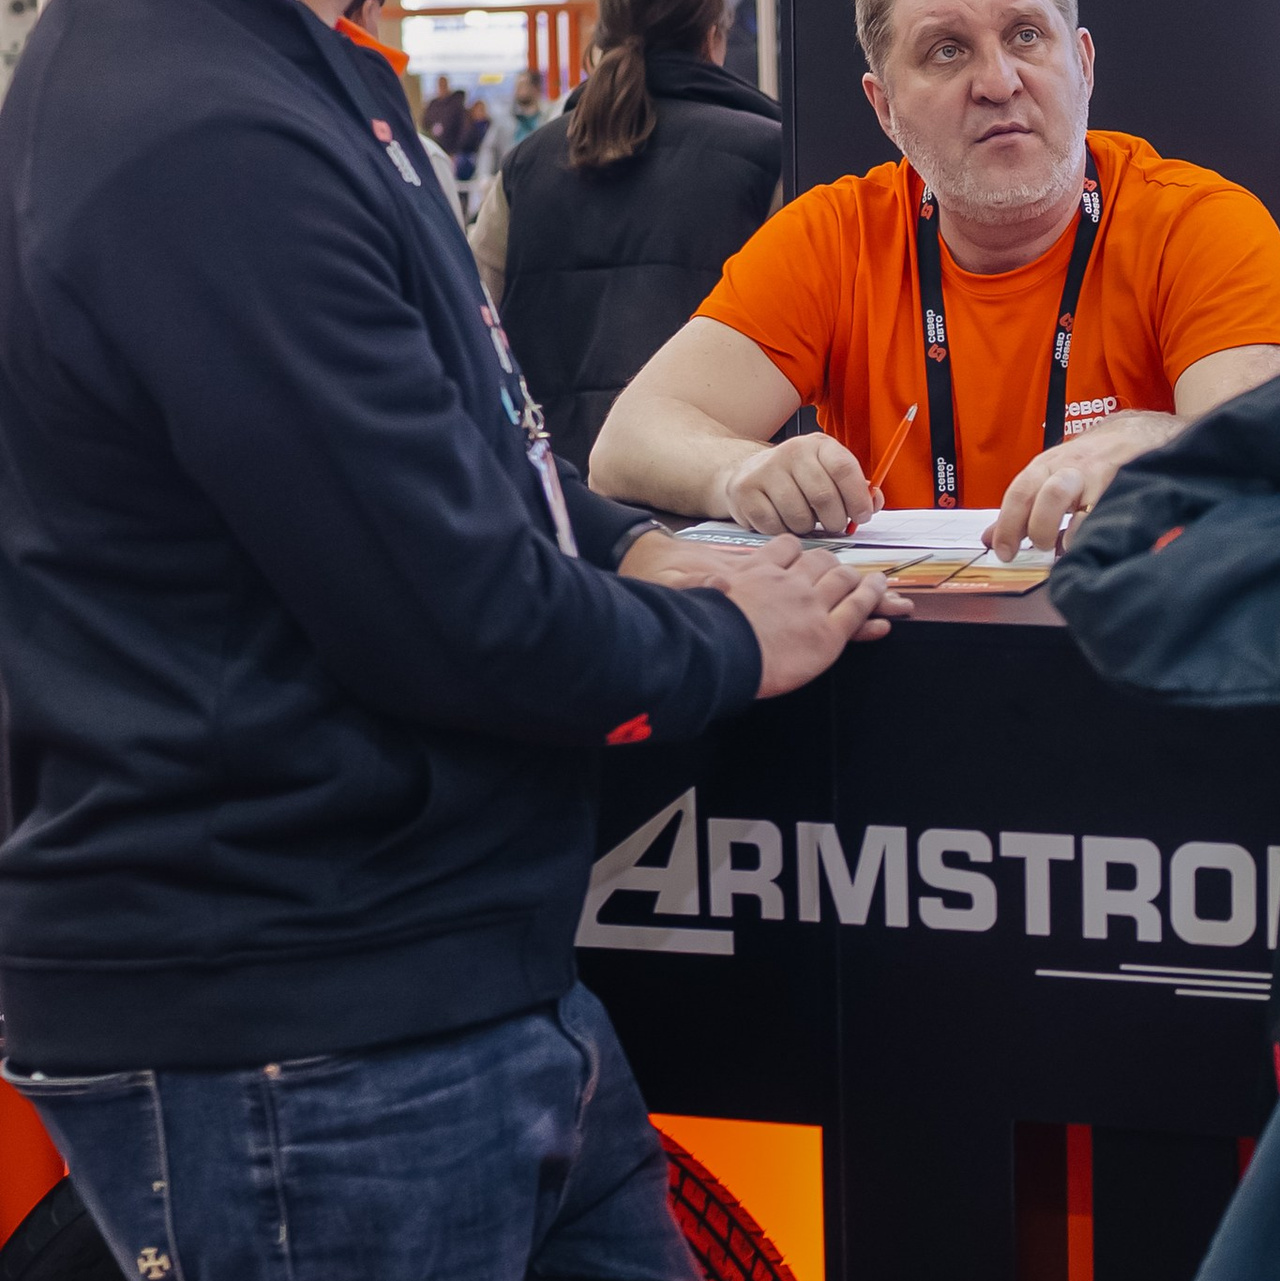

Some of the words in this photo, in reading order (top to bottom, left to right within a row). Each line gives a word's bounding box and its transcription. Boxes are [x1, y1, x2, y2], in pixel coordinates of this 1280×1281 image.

[1091, 192, 1101, 223] север
[926, 309, 936, 343] север
[936, 315, 945, 342] авто
[1054, 332, 1065, 360] авто
[937, 457, 947, 492] север
[946, 463, 955, 491] авто
